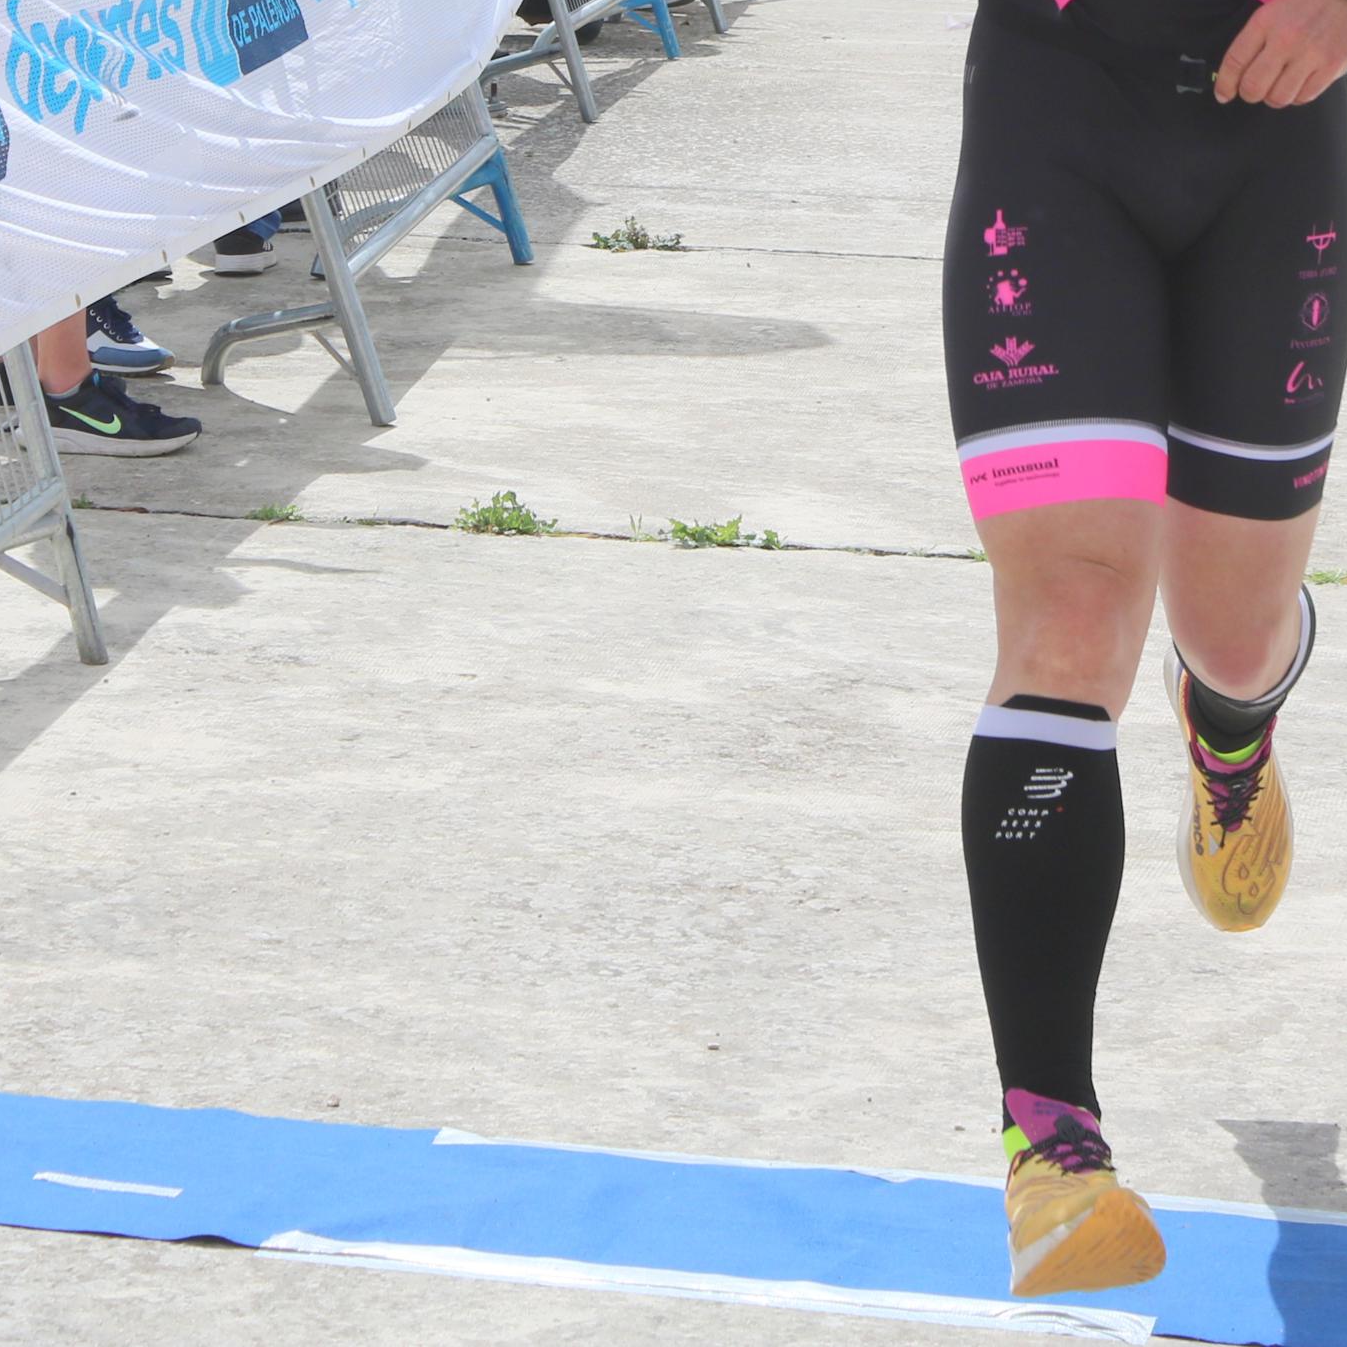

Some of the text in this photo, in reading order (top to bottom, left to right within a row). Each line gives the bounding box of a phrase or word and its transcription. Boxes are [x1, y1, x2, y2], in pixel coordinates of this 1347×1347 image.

[231, 12, 252, 48] DE
[973, 363, 1059, 385] CAJA RURAL
[991, 457, 1059, 479] innusual
